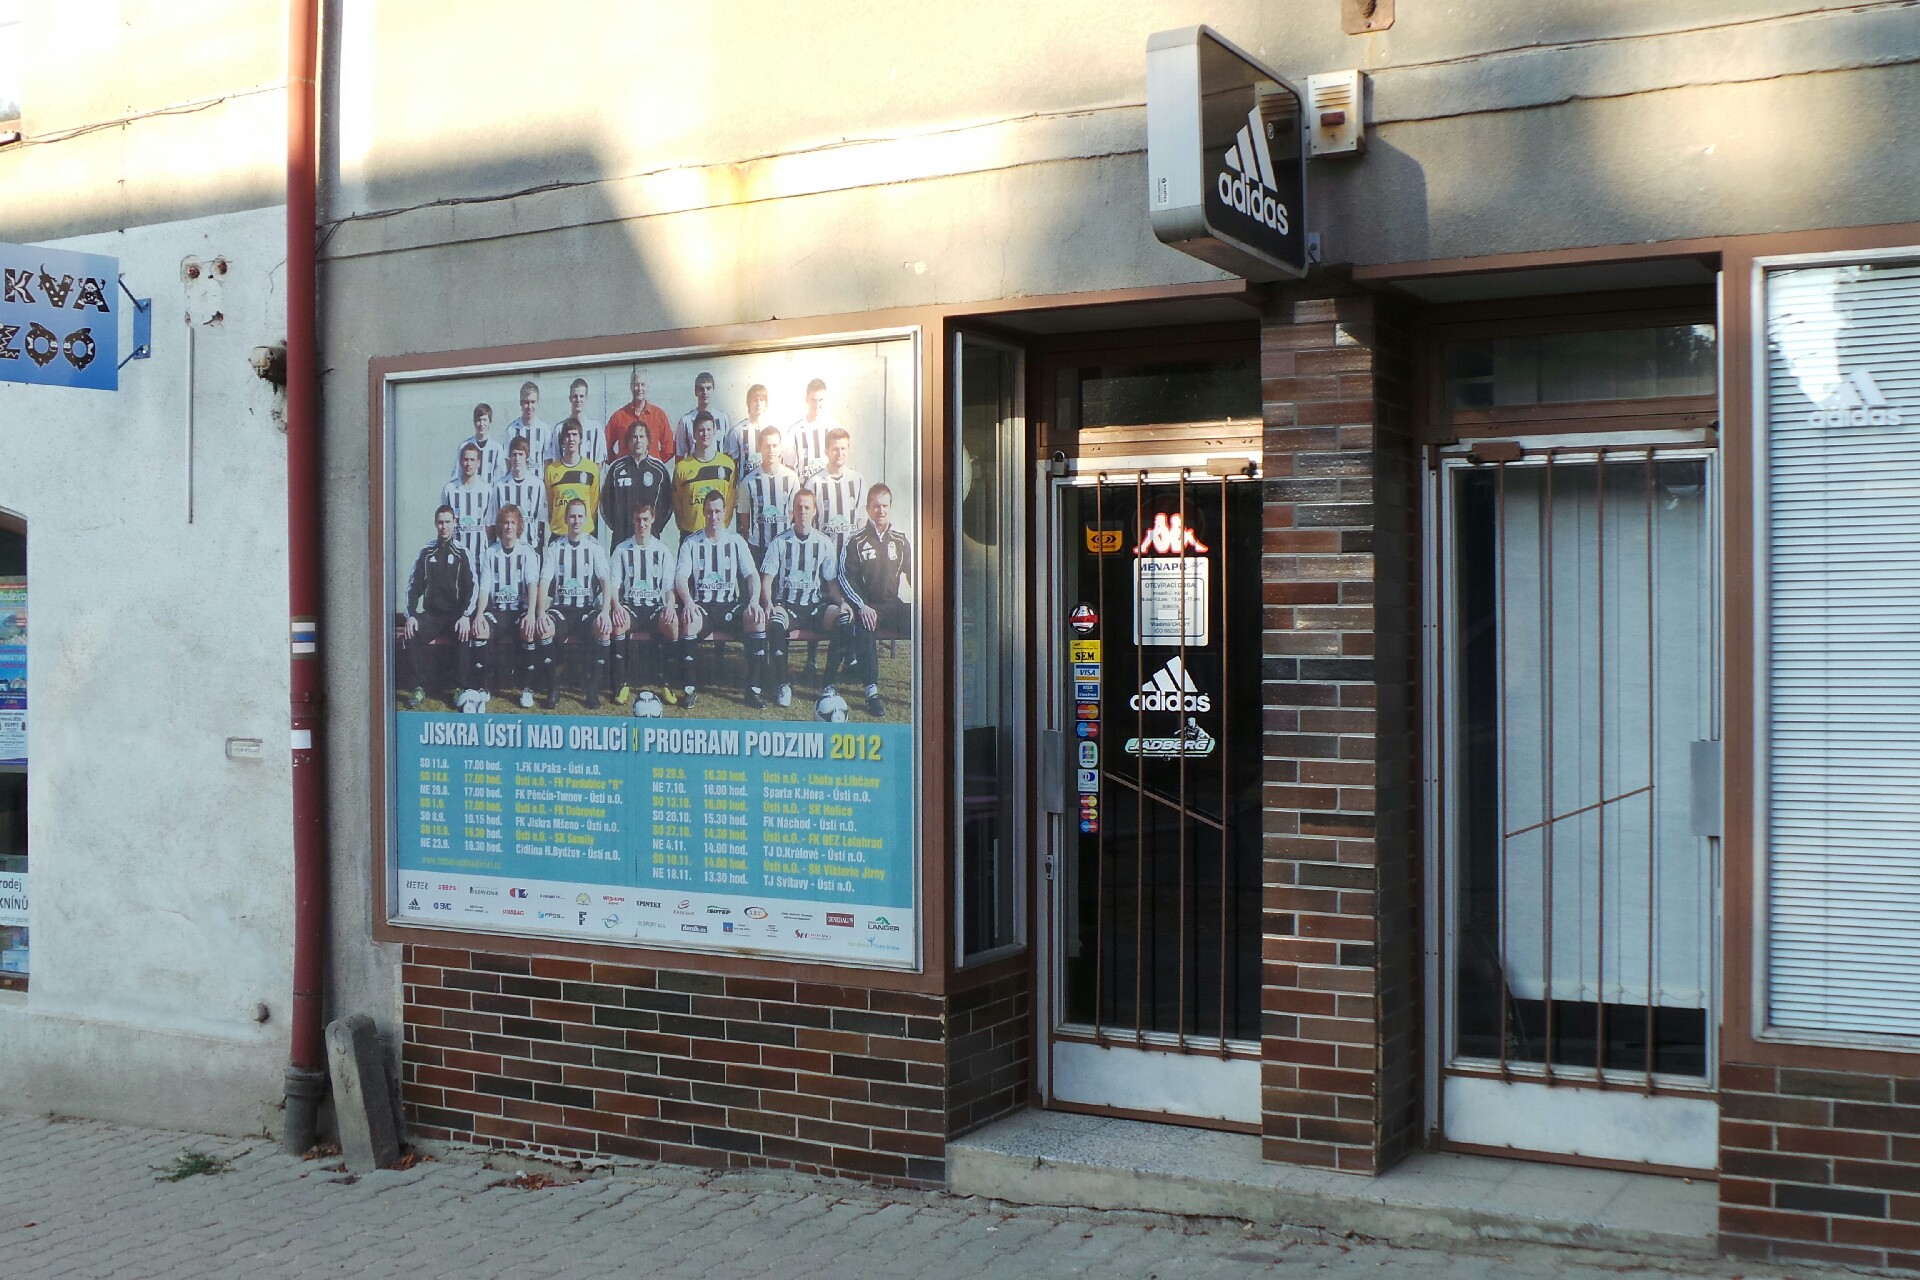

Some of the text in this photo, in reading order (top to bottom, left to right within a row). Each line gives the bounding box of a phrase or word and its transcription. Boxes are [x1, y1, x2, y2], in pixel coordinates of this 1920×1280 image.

[1218, 172, 1289, 236] adidas
[5, 264, 110, 313] KVA
[0, 322, 95, 371] ZOO
[1807, 407, 1901, 426] adidas
[1075, 652, 1094, 660] SEM
[1130, 691, 1210, 712] adidas
[419, 719, 882, 761] JISKRA ÚSTÍ NAD ORLICÍ PROGRAM PODZIM 2012
[420, 758, 430, 768] SO
[464, 760, 484, 770] 17.00
[486, 760, 502, 770] hod.
[516, 762, 531, 772] 1.FK
[534, 763, 561, 774] N.Paka
[586, 764, 600, 775] n.O.
[420, 784, 430, 794] NE
[464, 787, 484, 796] 17.00
[486, 788, 502, 798] hod.
[516, 789, 524, 799] FK
[608, 794, 622, 804] n.O.
[652, 782, 870, 802] NE 7.10. 16.00 hod. Sparta K.Hora Ústí n.O.
[420, 811, 430, 820] SO
[432, 812, 445, 822] 8.9.
[464, 814, 484, 824] 10.15
[486, 815, 502, 825] hod.
[516, 816, 525, 826] FK
[528, 817, 550, 828] Jiskra
[553, 818, 578, 830] Mšeno
[604, 822, 619, 832] n.O.
[652, 810, 856, 832] SO 20.10. 15.30 hod. FK Náchod Ústí n.O.
[486, 828, 502, 838] hod.
[420, 838, 430, 848] NE
[432, 839, 450, 848] 23.9.
[464, 840, 484, 850] 16.30
[486, 842, 502, 852] hod.
[605, 850, 620, 860] n.O.
[652, 839, 865, 862] NE 4.11. 14.00 hod. TJ D.Králové Ústí n.O.
[652, 868, 854, 892] NE 18.11. 13.30 hod. TJ Svitavy Ústí n.O.
